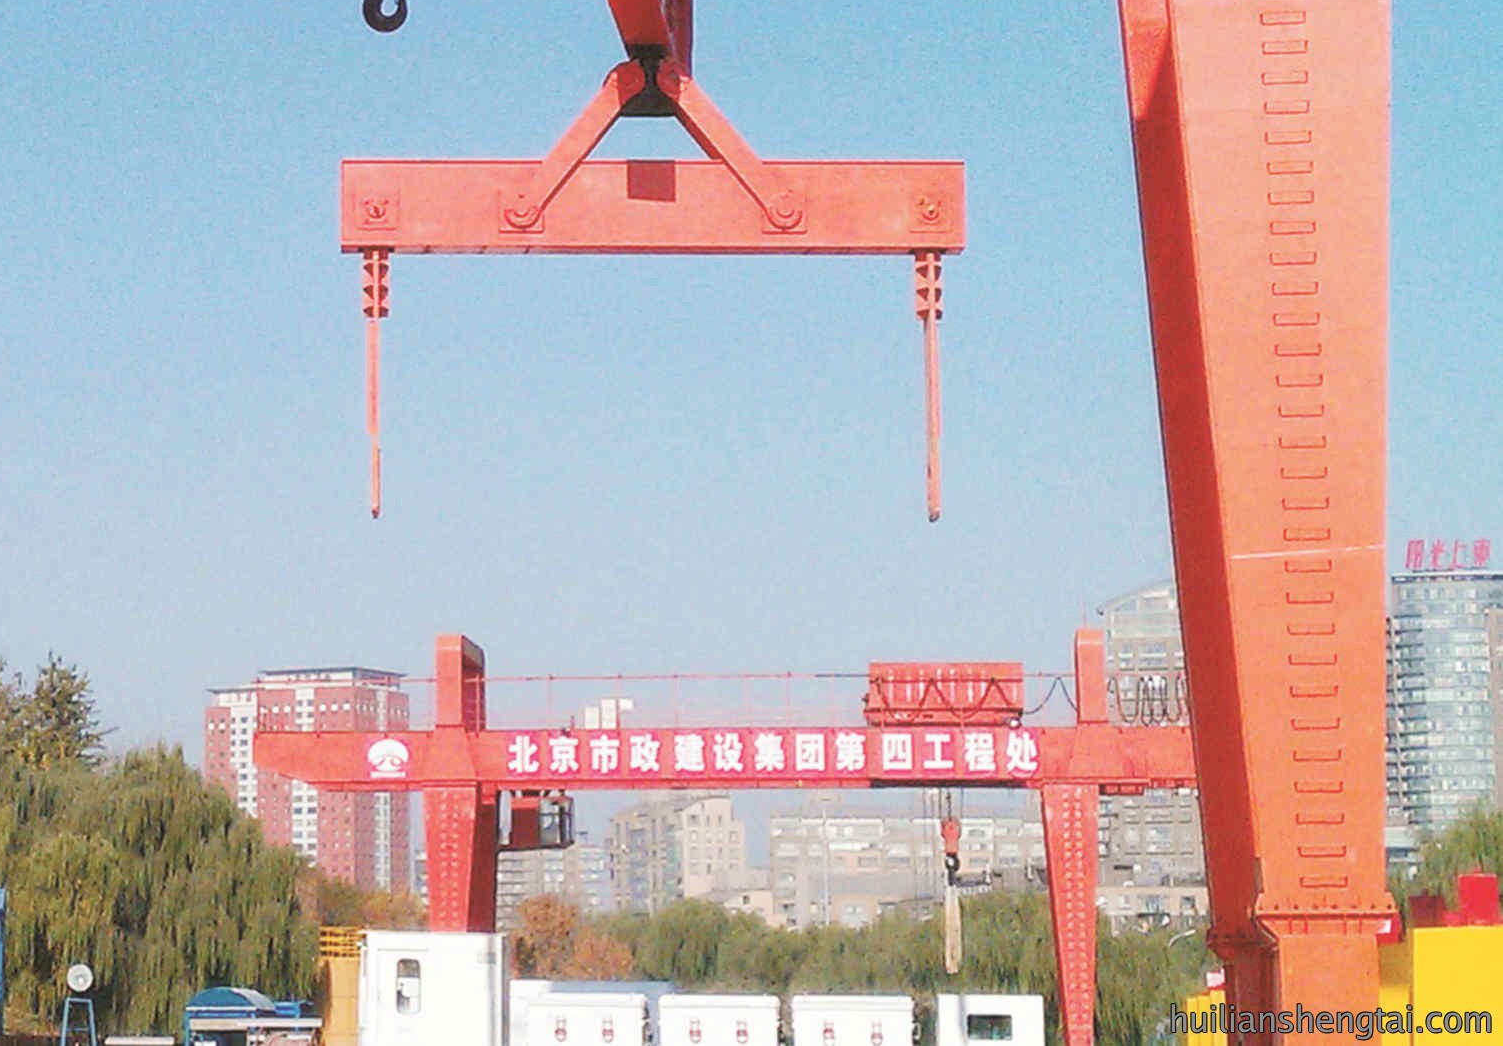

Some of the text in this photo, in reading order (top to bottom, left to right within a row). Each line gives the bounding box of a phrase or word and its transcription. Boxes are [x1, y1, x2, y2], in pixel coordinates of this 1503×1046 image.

[507, 732, 1038, 774] 北京市政建设集团第四工程处
